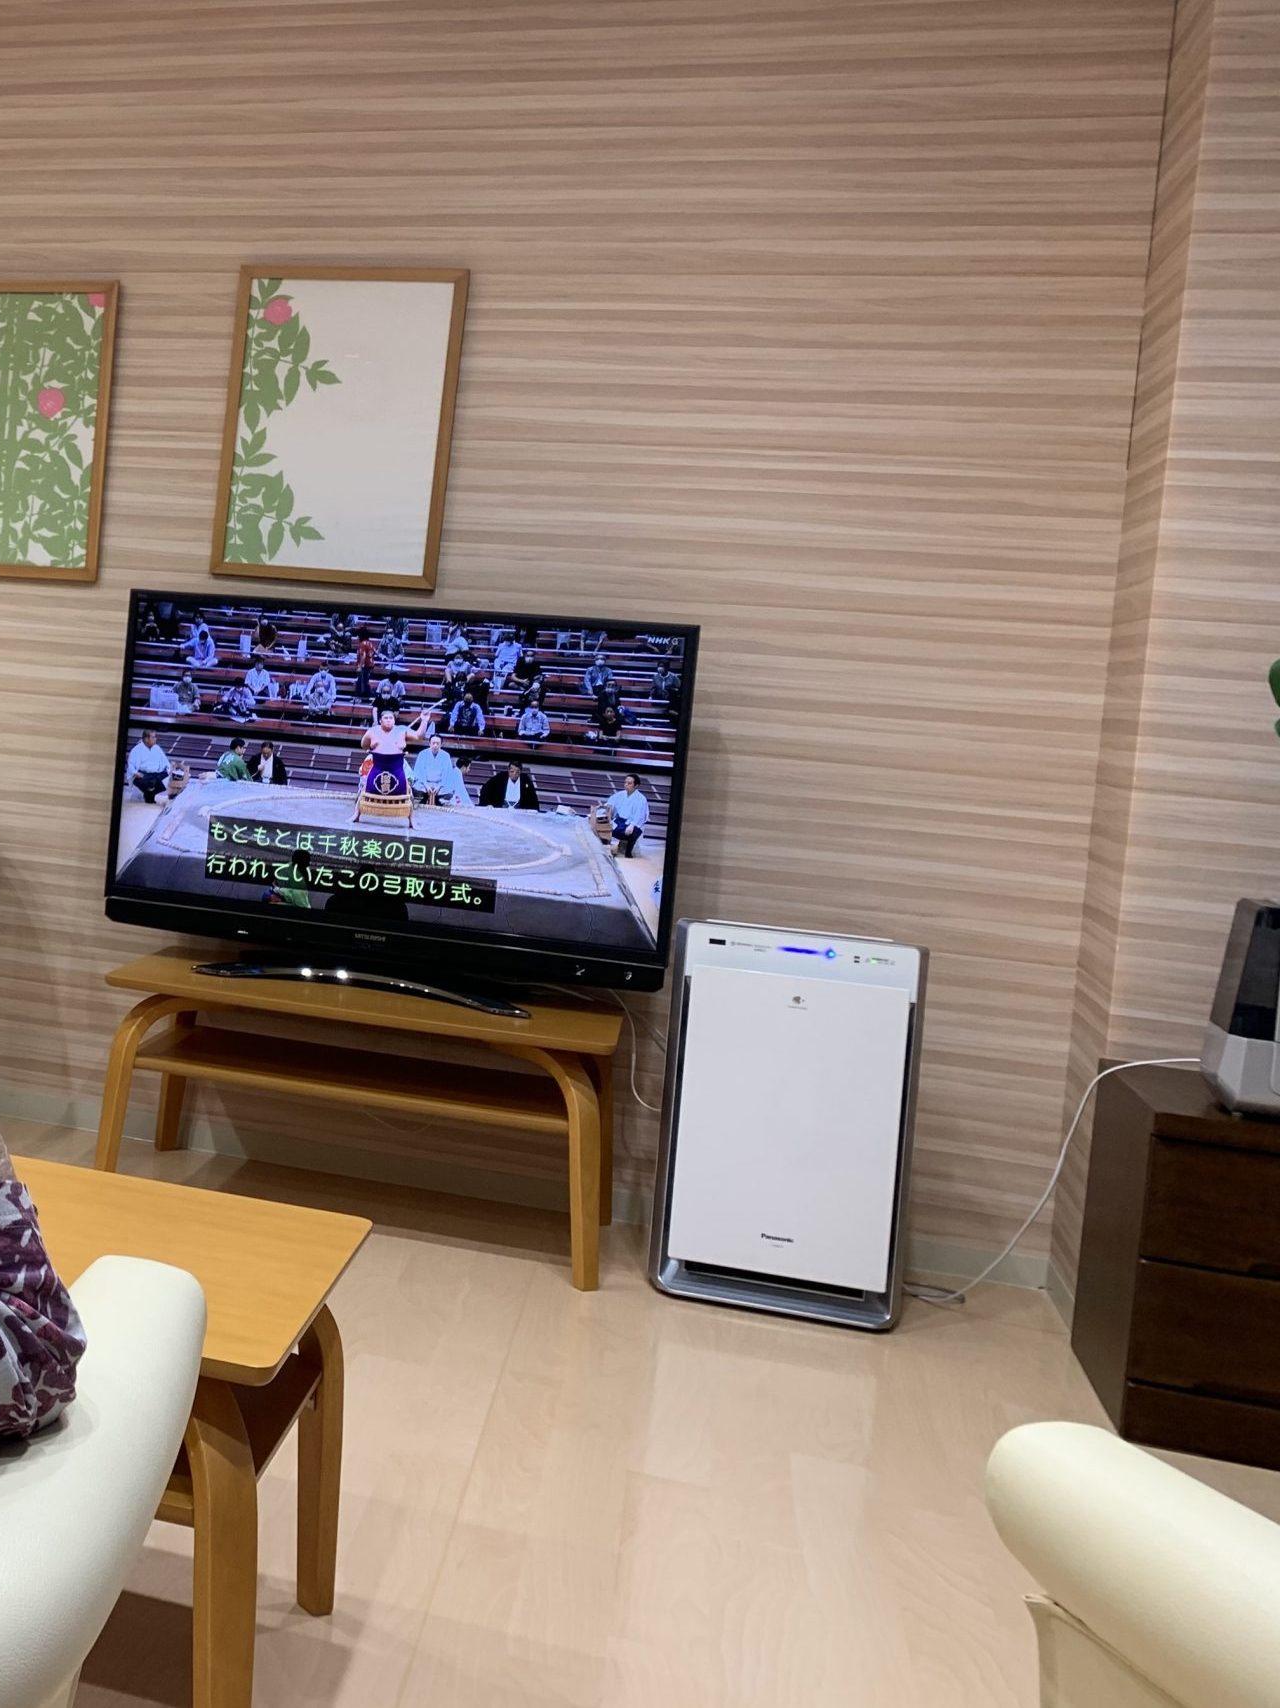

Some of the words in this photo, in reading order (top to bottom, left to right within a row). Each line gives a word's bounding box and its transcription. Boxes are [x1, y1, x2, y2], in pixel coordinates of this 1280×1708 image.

[647, 636, 671, 645] NHK
[210, 822, 450, 866] もともとは千秋楽の日に
[206, 853, 482, 905] 行われていたこの弓取り式。
